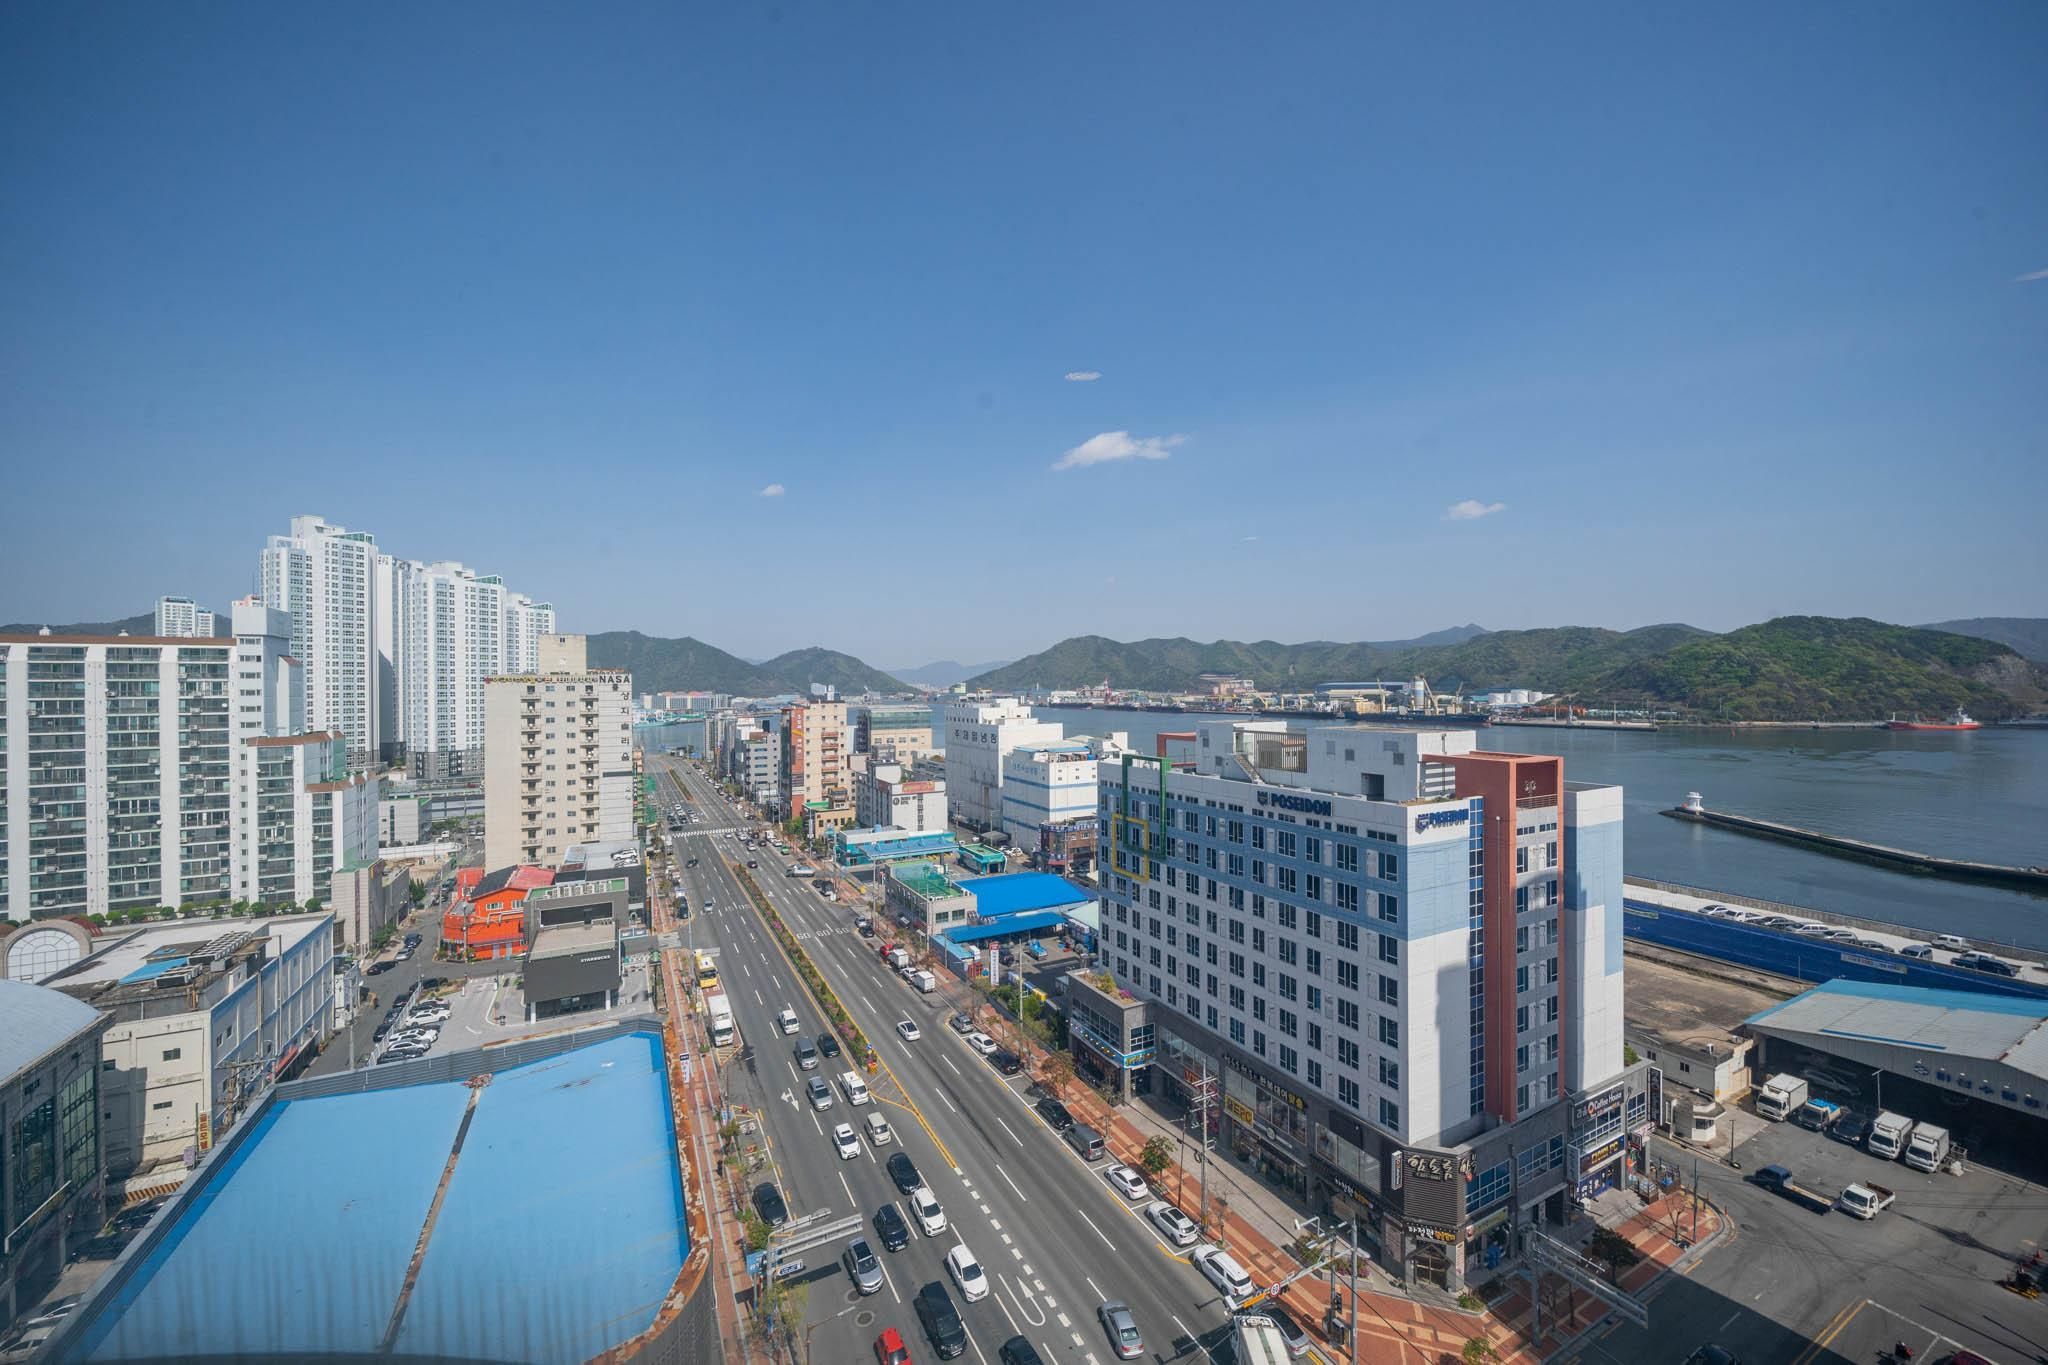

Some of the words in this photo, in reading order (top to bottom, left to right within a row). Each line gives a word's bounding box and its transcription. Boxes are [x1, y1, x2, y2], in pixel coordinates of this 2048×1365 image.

[599, 675, 630, 684] NASA
[1270, 792, 1332, 816] POSEIDON
[1608, 1091, 1622, 1103] House
